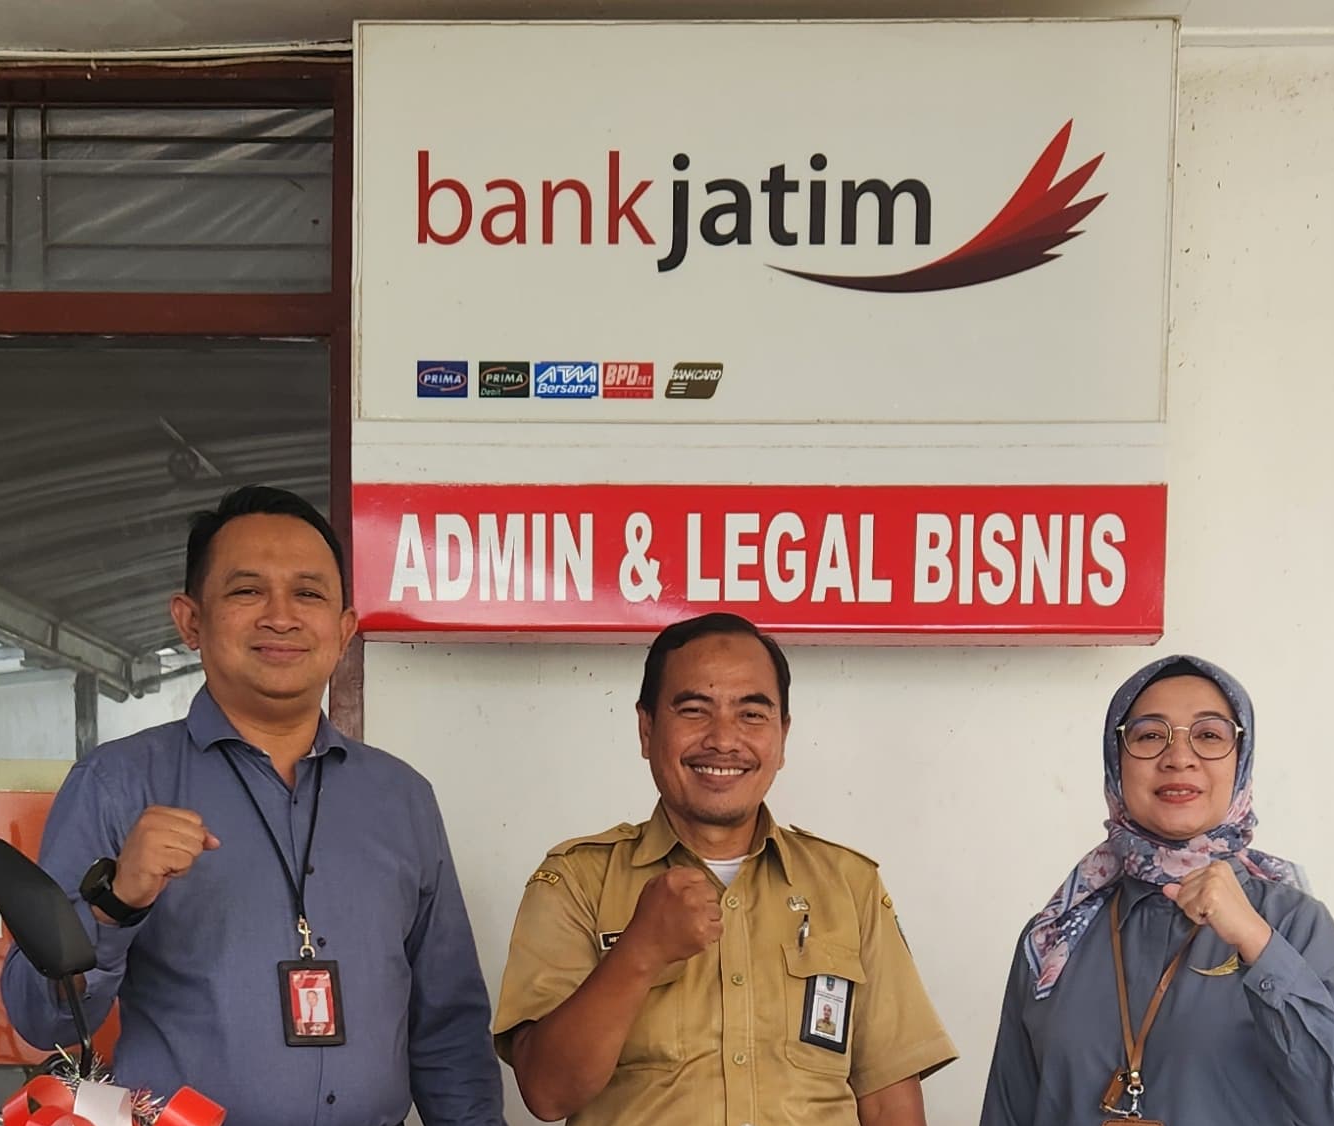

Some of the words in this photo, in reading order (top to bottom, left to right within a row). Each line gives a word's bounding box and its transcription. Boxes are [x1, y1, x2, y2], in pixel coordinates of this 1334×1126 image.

[418, 150, 932, 273] bankjatim
[423, 373, 462, 384] PRIMA
[485, 373, 524, 383] PRIMA
[536, 365, 597, 383] ATM
[536, 383, 596, 394] Bersama
[389, 512, 594, 602] ADMIN
[618, 511, 664, 604] &
[687, 512, 892, 605] LEGAL
[913, 512, 1127, 606] BISNIS
